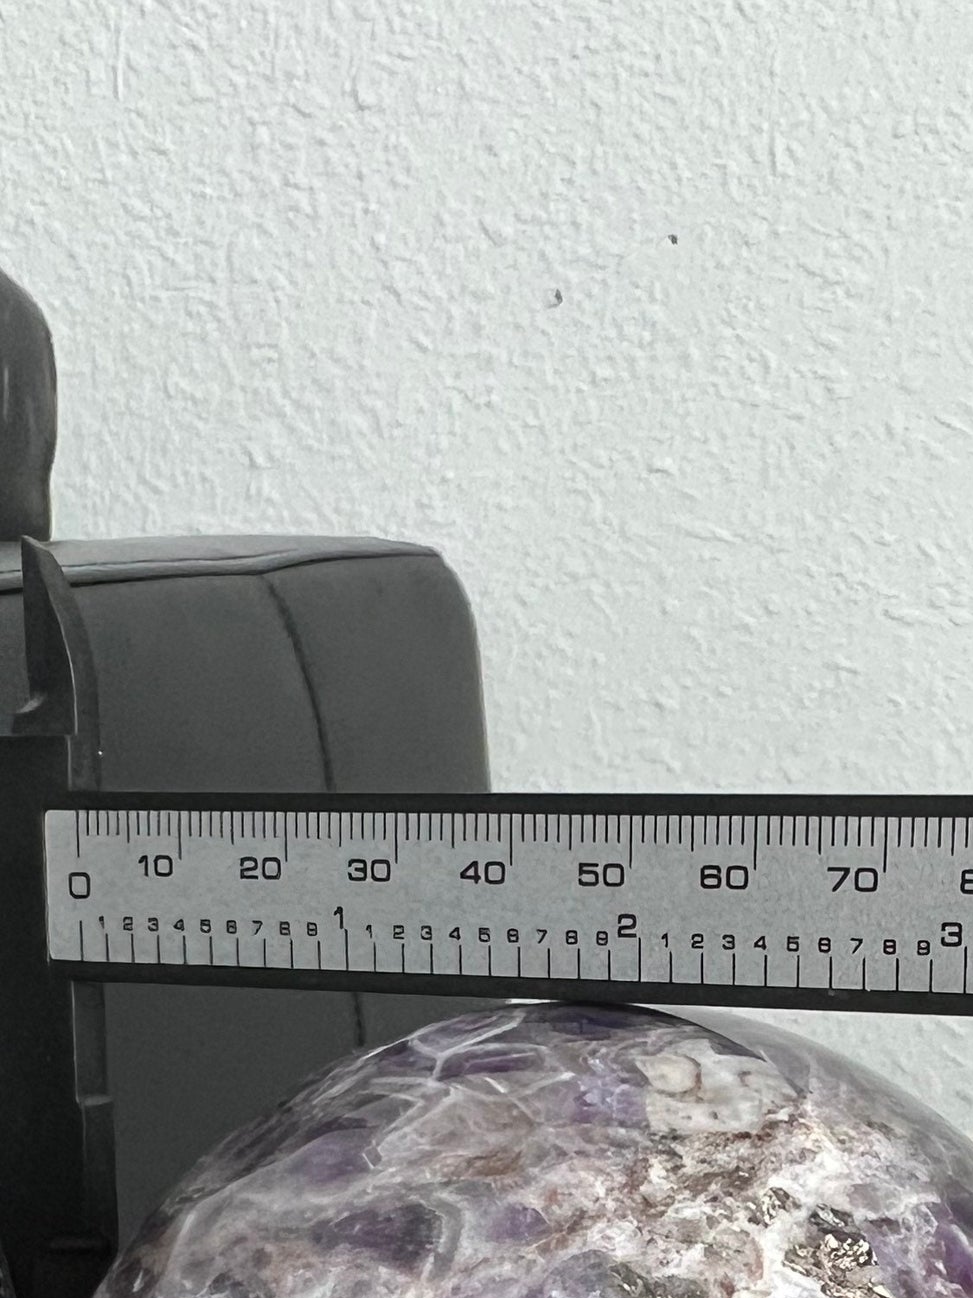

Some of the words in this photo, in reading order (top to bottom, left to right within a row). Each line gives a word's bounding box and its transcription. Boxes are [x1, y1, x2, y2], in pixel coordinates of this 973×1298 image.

[68, 872, 91, 899] 0
[138, 855, 173, 877] 10
[240, 856, 282, 880] 20
[347, 859, 391, 882] 30
[460, 860, 506, 884] 40
[578, 862, 625, 887] 50
[700, 865, 749, 890] 60
[827, 867, 878, 892] 70
[98, 916, 105, 929] 1
[123, 916, 134, 931] 2
[148, 917, 159, 932] 3
[173, 918, 185, 932] 4
[252, 920, 263, 935] 7
[279, 921, 291, 936] 8
[306, 922, 318, 937] 9
[333, 906, 344, 929] 1
[366, 924, 373, 938] 1
[393, 925, 405, 940] 2
[420, 925, 433, 940] 3
[449, 927, 461, 941] 4
[536, 929, 548, 944] 7
[565, 930, 578, 945] 8
[596, 930, 609, 946] 9
[617, 913, 637, 938] 2
[661, 933, 668, 948] 1
[691, 933, 704, 949] 2
[722, 934, 735, 950] 3
[753, 935, 767, 950] 4
[850, 938, 864, 954] 7
[883, 939, 896, 955] 8
[917, 940, 931, 956] 9
[941, 922, 963, 947] 3
